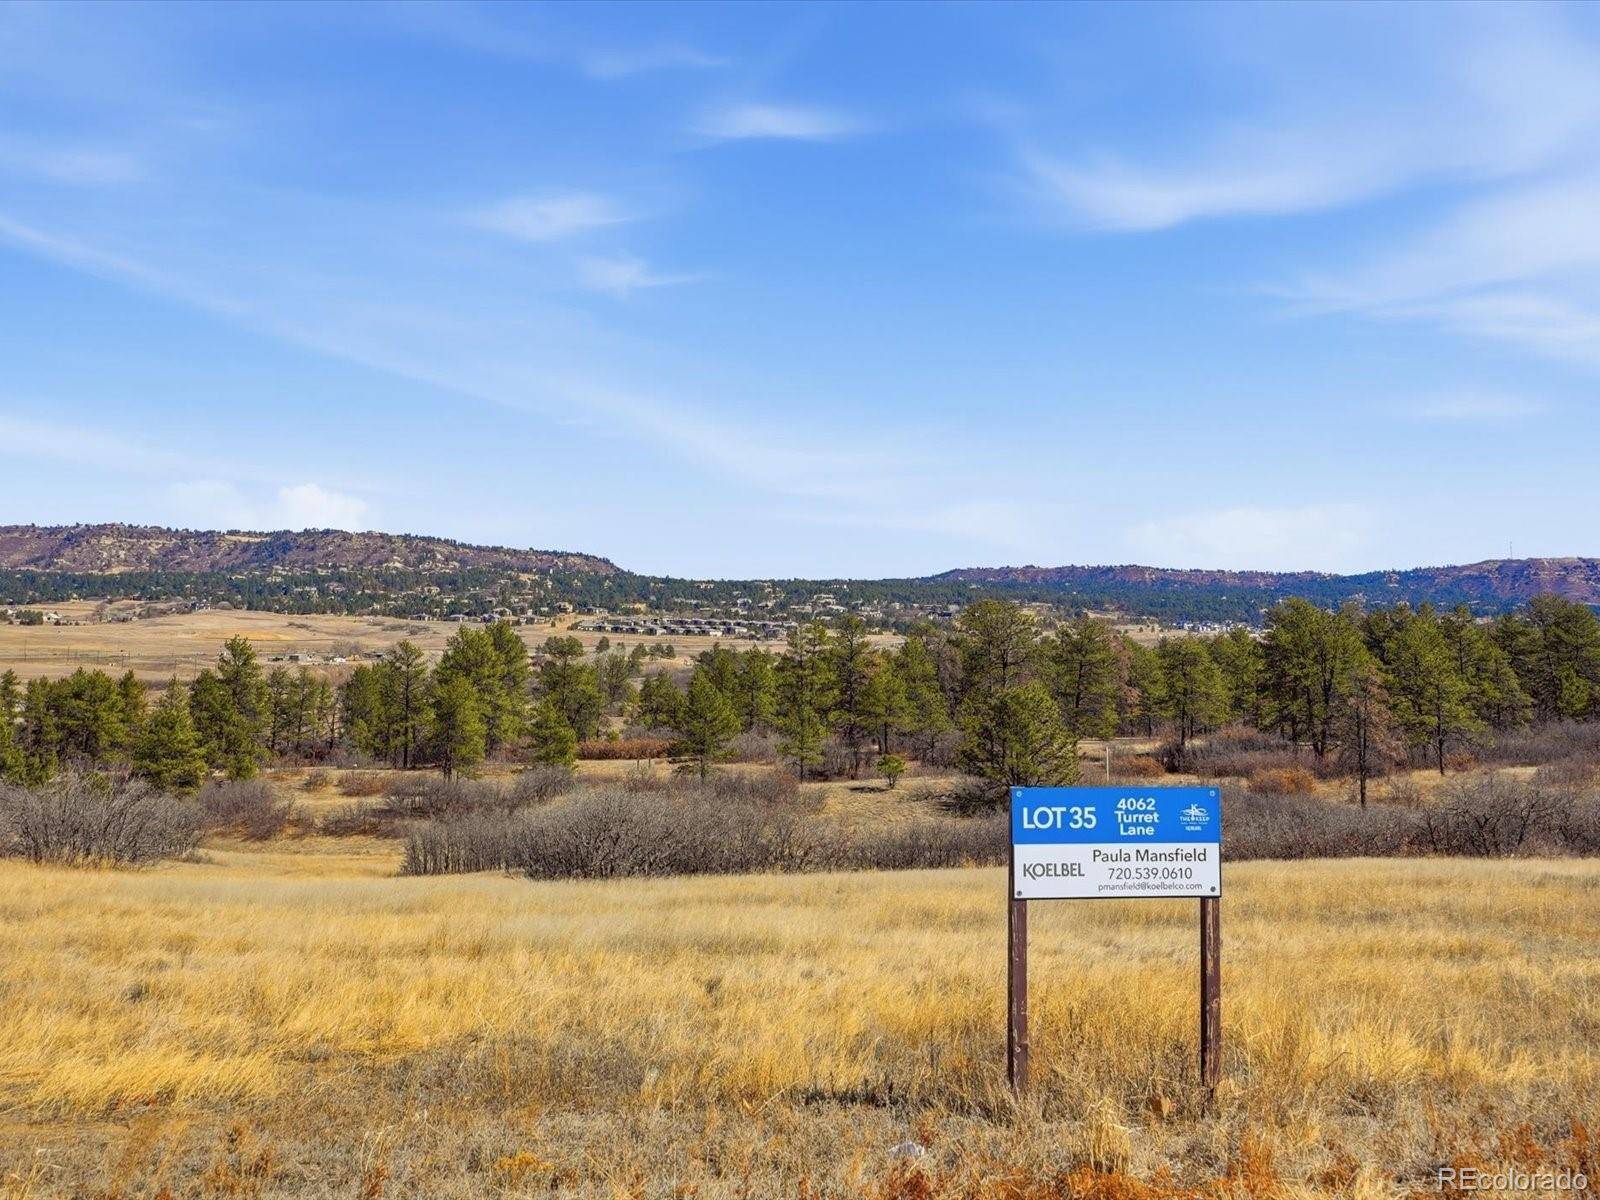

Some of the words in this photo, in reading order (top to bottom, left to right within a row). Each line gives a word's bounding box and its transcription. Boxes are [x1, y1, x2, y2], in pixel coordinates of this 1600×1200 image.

[1116, 798, 1156, 811] 4062
[1023, 806, 1066, 829] LOT
[1069, 806, 1097, 829] 35
[1115, 811, 1160, 824] Turret
[1120, 824, 1155, 836] Lane
[1093, 849, 1131, 863] Paula
[1136, 849, 1207, 862] Mansfield
[1023, 863, 1085, 880] KOELBEL
[1108, 867, 1193, 880] 720.539.0610
[1098, 881, 1203, 892] pmansfield@koelbelco.com
